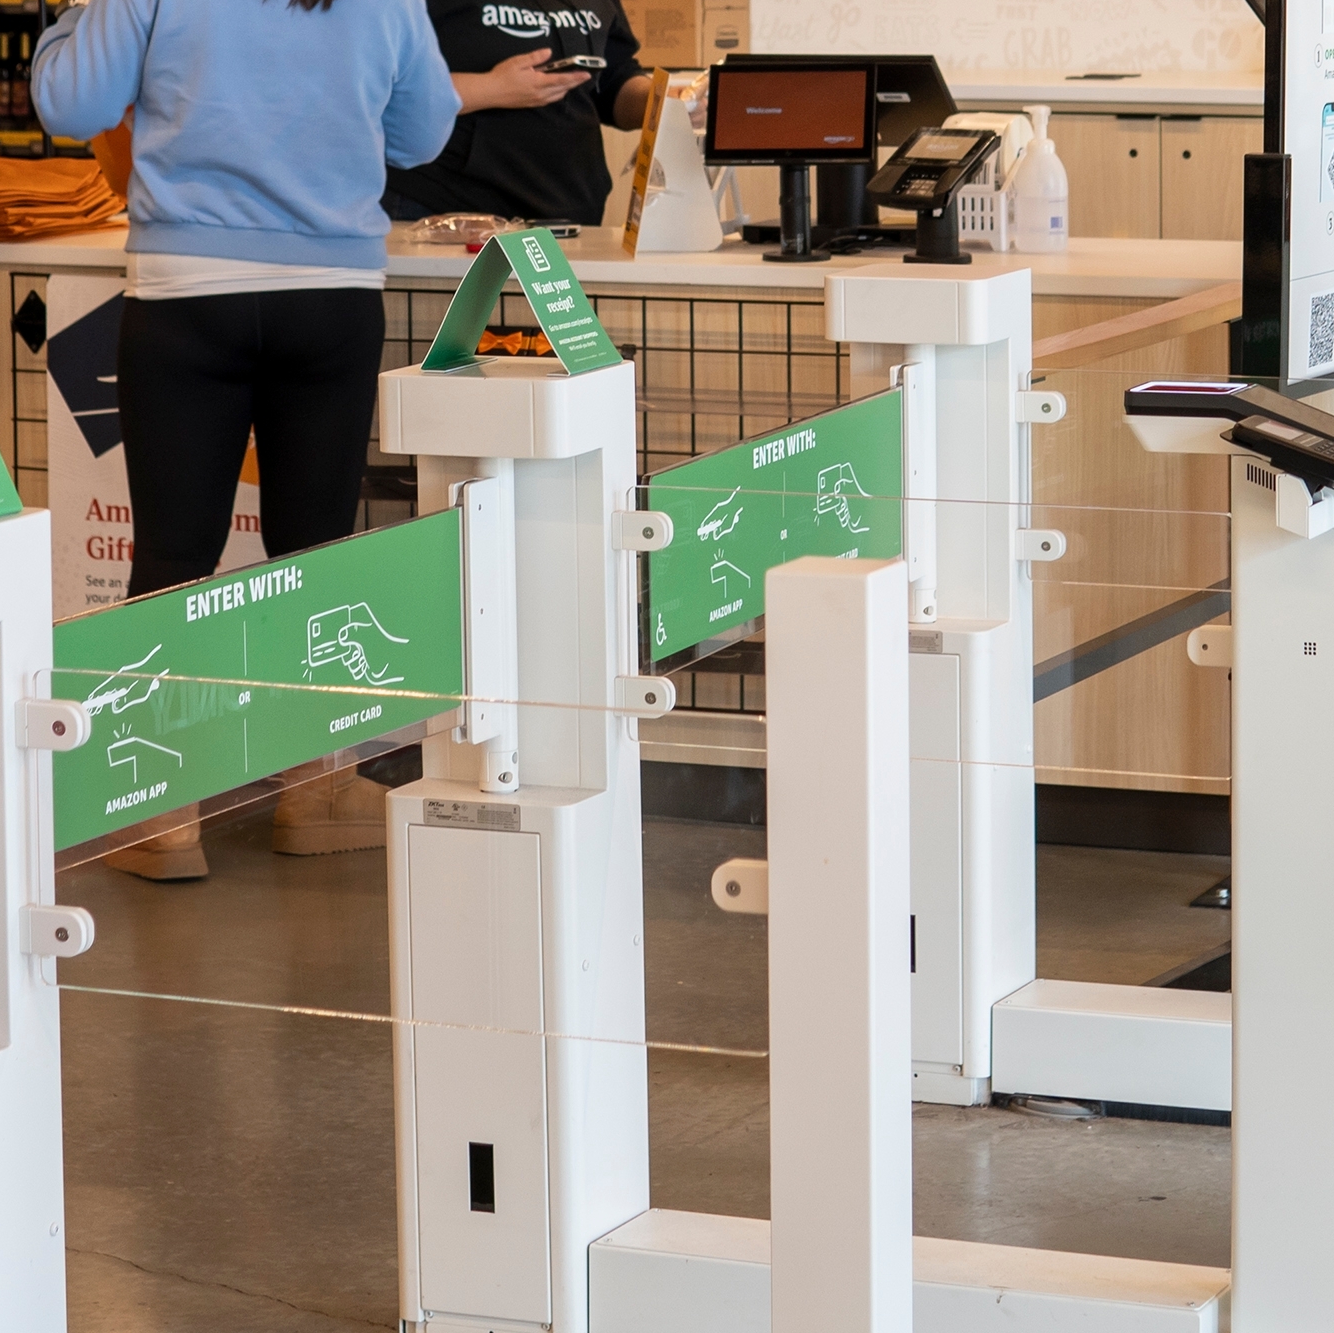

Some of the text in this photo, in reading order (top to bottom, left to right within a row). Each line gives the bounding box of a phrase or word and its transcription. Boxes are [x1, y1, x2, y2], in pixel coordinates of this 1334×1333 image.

[531, 279, 571, 295] Want your
[546, 295, 575, 314] receipt?
[753, 428, 816, 469] ENTER WITH:
[780, 529, 787, 540] OR
[86, 575, 122, 589] See an
[186, 565, 303, 623] ENTER WITH:
[709, 598, 743, 623] AMAZON APP
[238, 691, 251, 705] OR
[329, 705, 382, 734] CREDIT CARD
[105, 781, 167, 815] AMAZON APP
